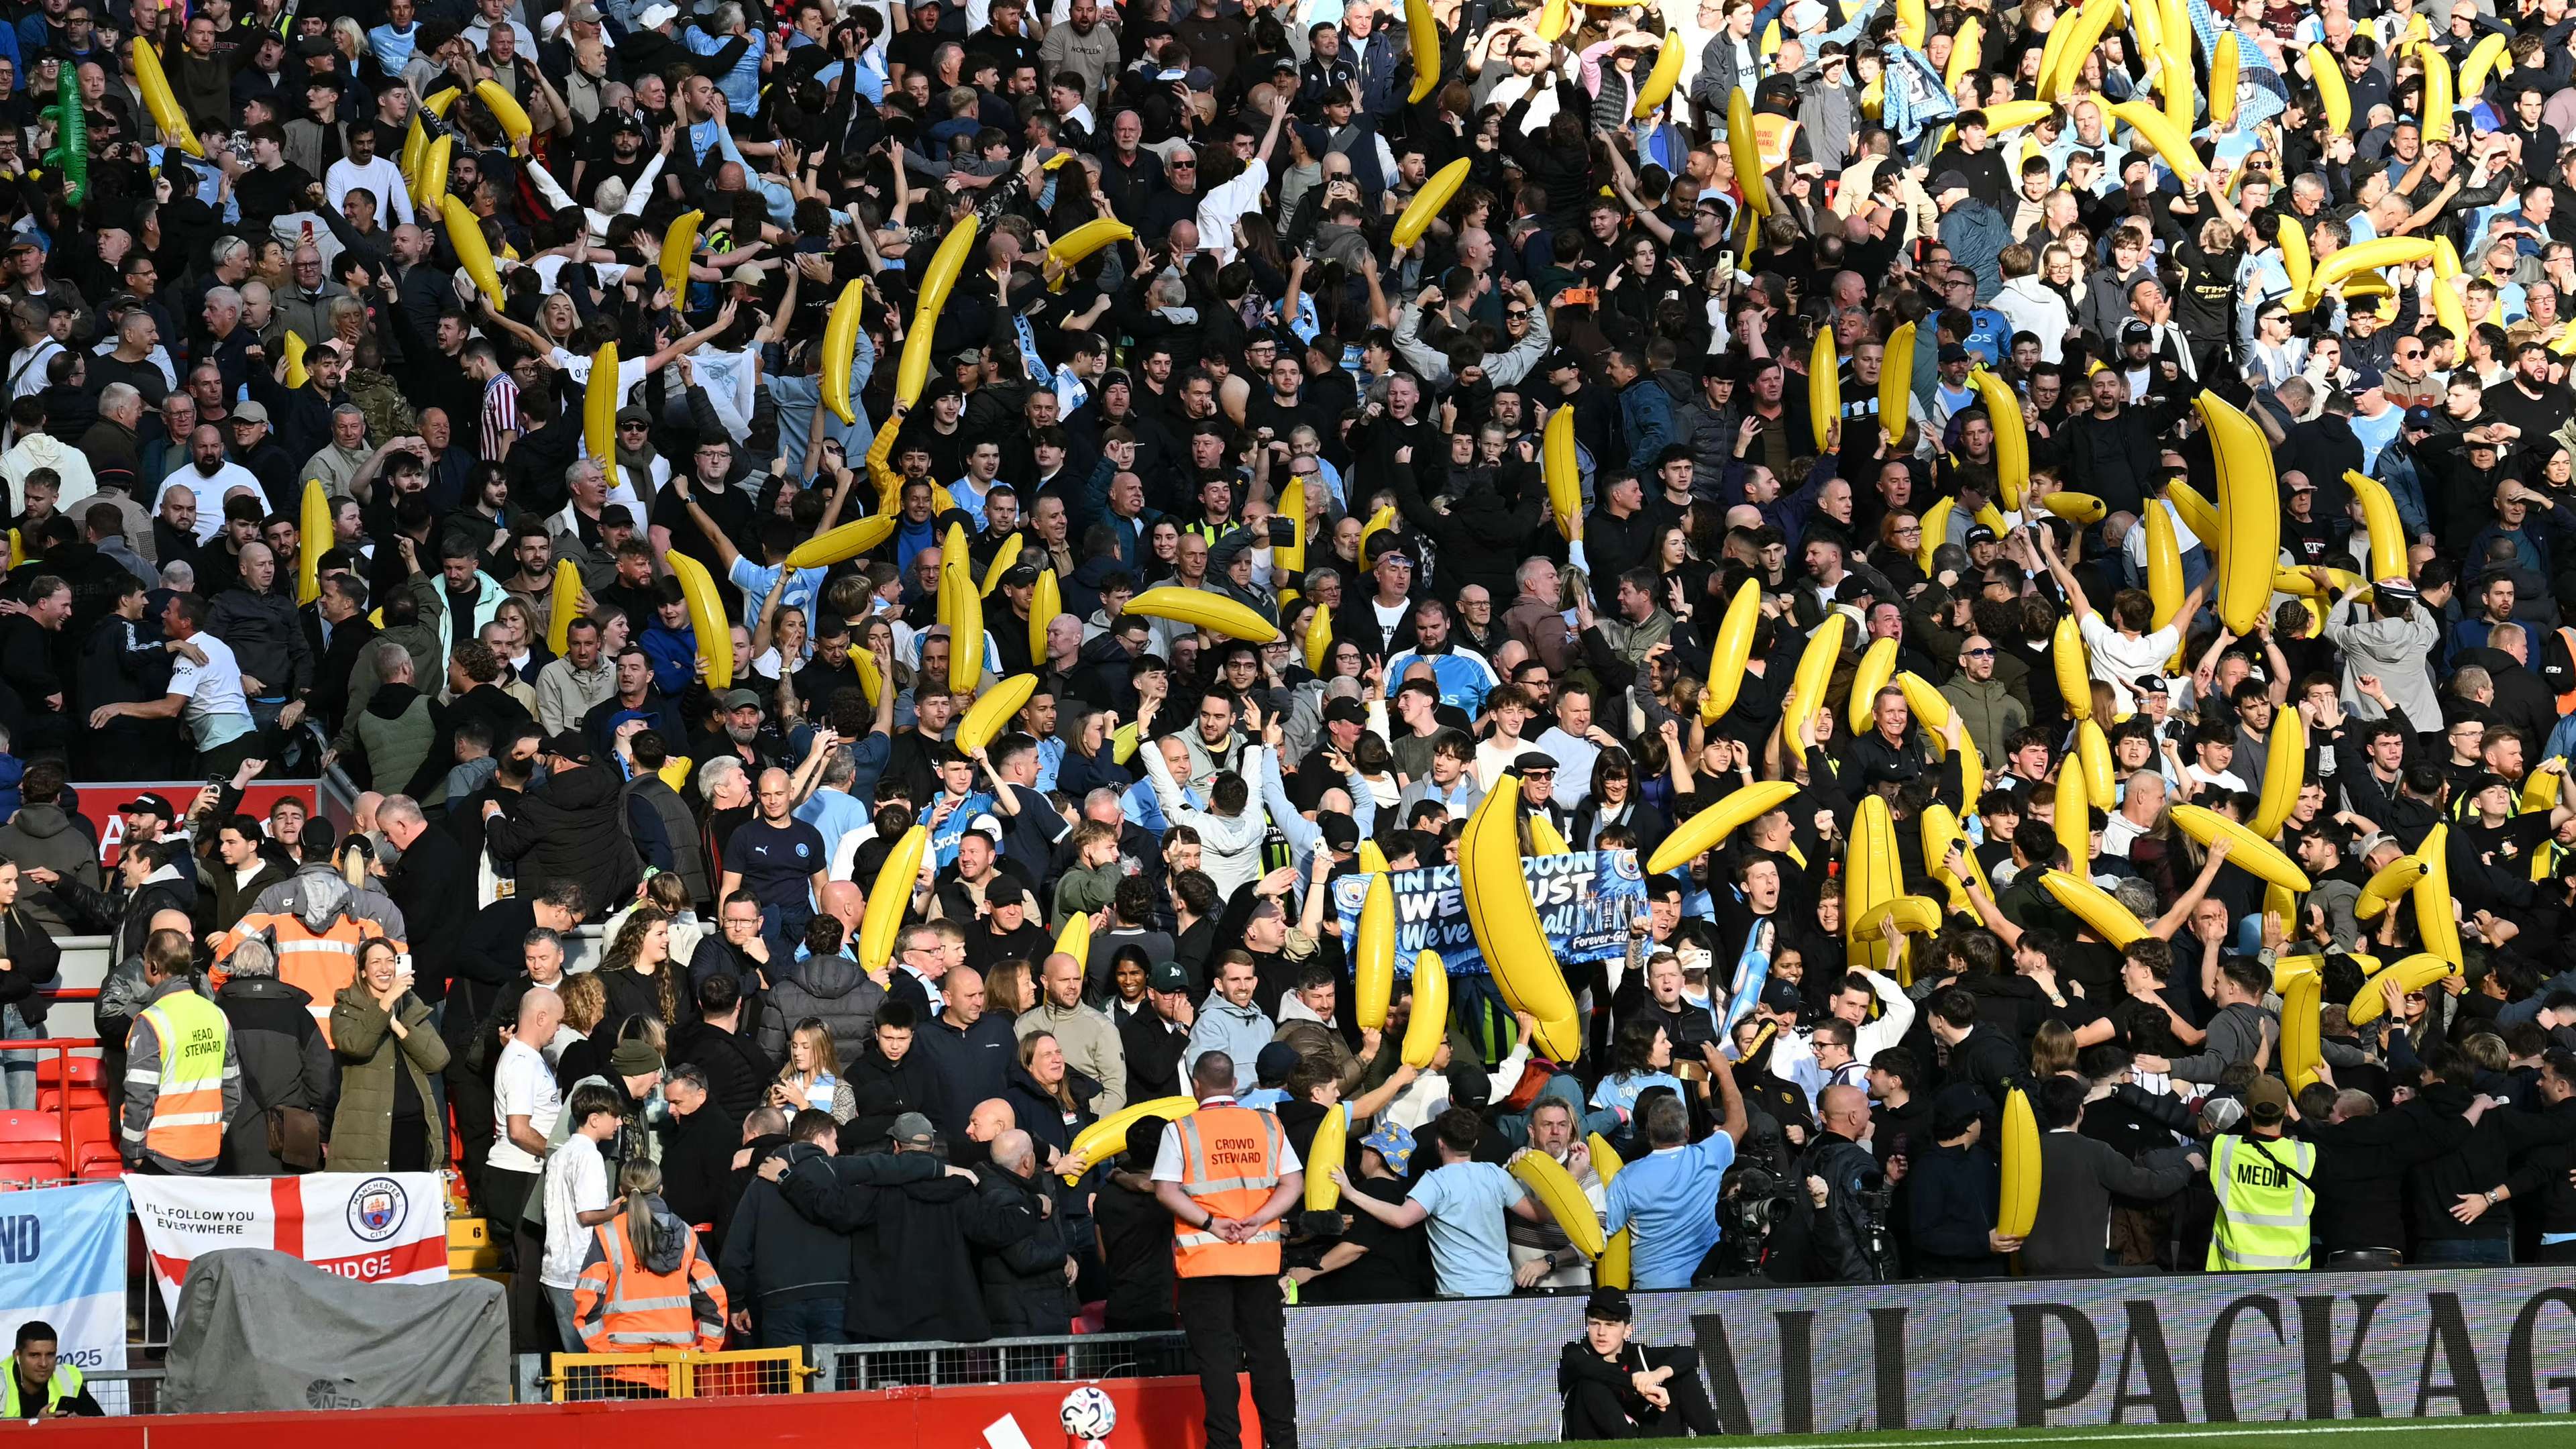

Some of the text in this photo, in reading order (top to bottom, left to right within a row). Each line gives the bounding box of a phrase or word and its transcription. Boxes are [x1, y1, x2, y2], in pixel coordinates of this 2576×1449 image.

[1394, 871, 1426, 893] IN
[1399, 889, 1462, 922] WE
[1402, 921, 1471, 951] We've
[192, 1028, 213, 1042] HEAD
[185, 1041, 221, 1058] STEWARD
[1215, 1138, 1254, 1150] CROWD
[1212, 1152, 1261, 1165] STEWARD
[2237, 1163, 2288, 1188] MEDIA
[353, 1182, 400, 1205] MANCHESTER
[168, 1209, 223, 1222] FOLLOW
[227, 1211, 254, 1221] YOU
[158, 1218, 243, 1234] EVERYWHERE
[370, 1230, 388, 1238] CITY
[473, 1227, 481, 1238] 6
